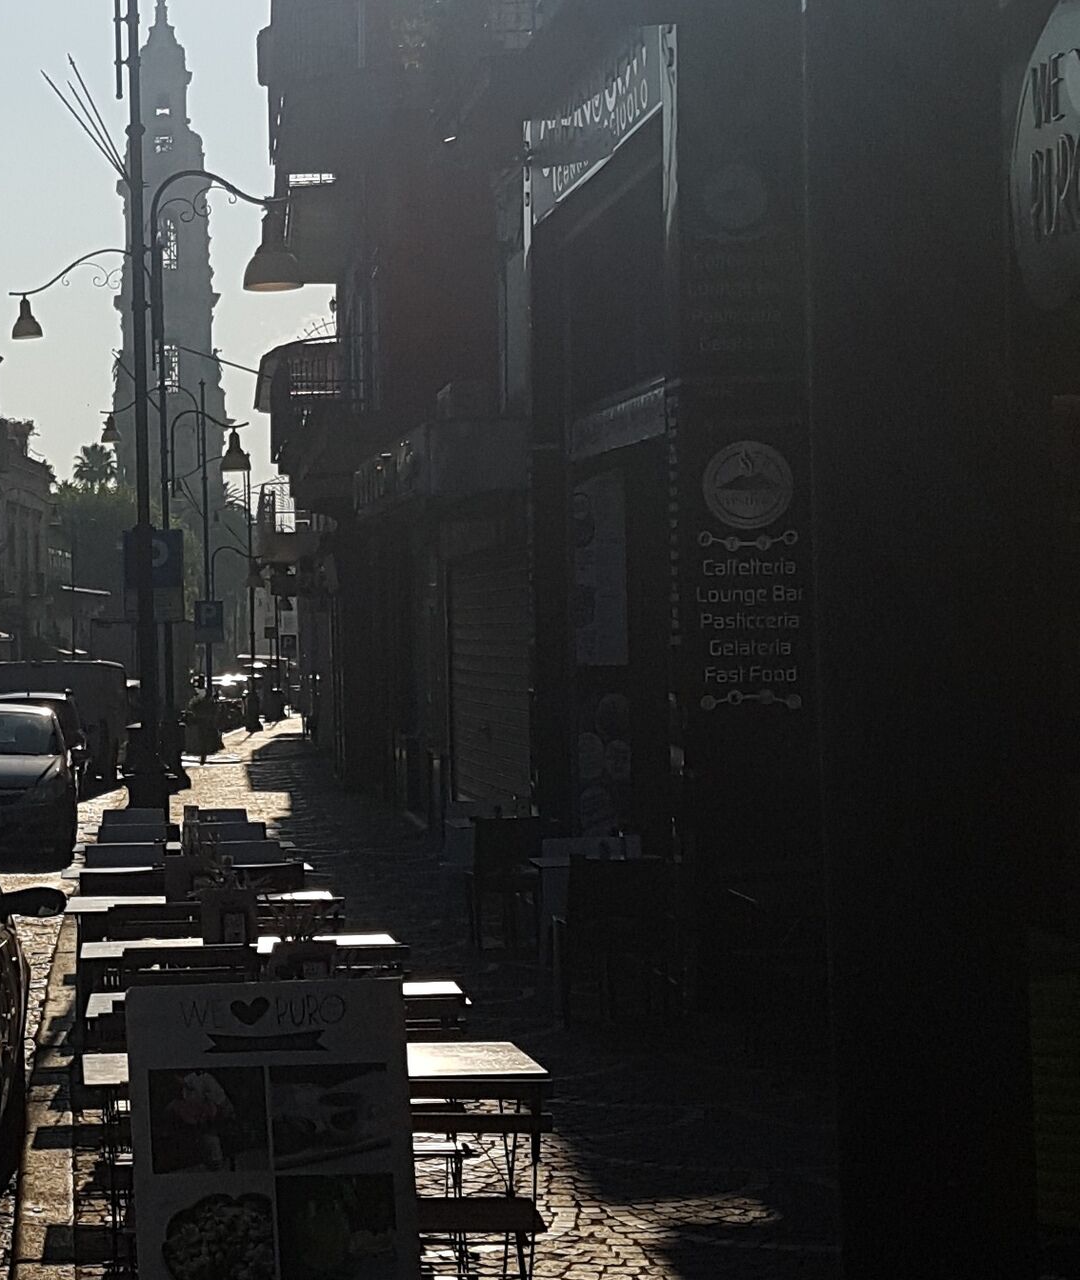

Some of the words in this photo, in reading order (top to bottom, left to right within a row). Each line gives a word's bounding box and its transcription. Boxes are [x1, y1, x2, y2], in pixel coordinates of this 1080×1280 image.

[702, 558, 797, 577] Caffetteria
[696, 585, 767, 606] Lounge
[773, 584, 804, 602] Bar
[700, 611, 800, 631] Pasticceria
[709, 638, 792, 657] Gelateria
[704, 665, 744, 683] Fast
[749, 664, 798, 683] Food
[180, 999, 225, 1029] WE
[275, 993, 346, 1025] PURO
